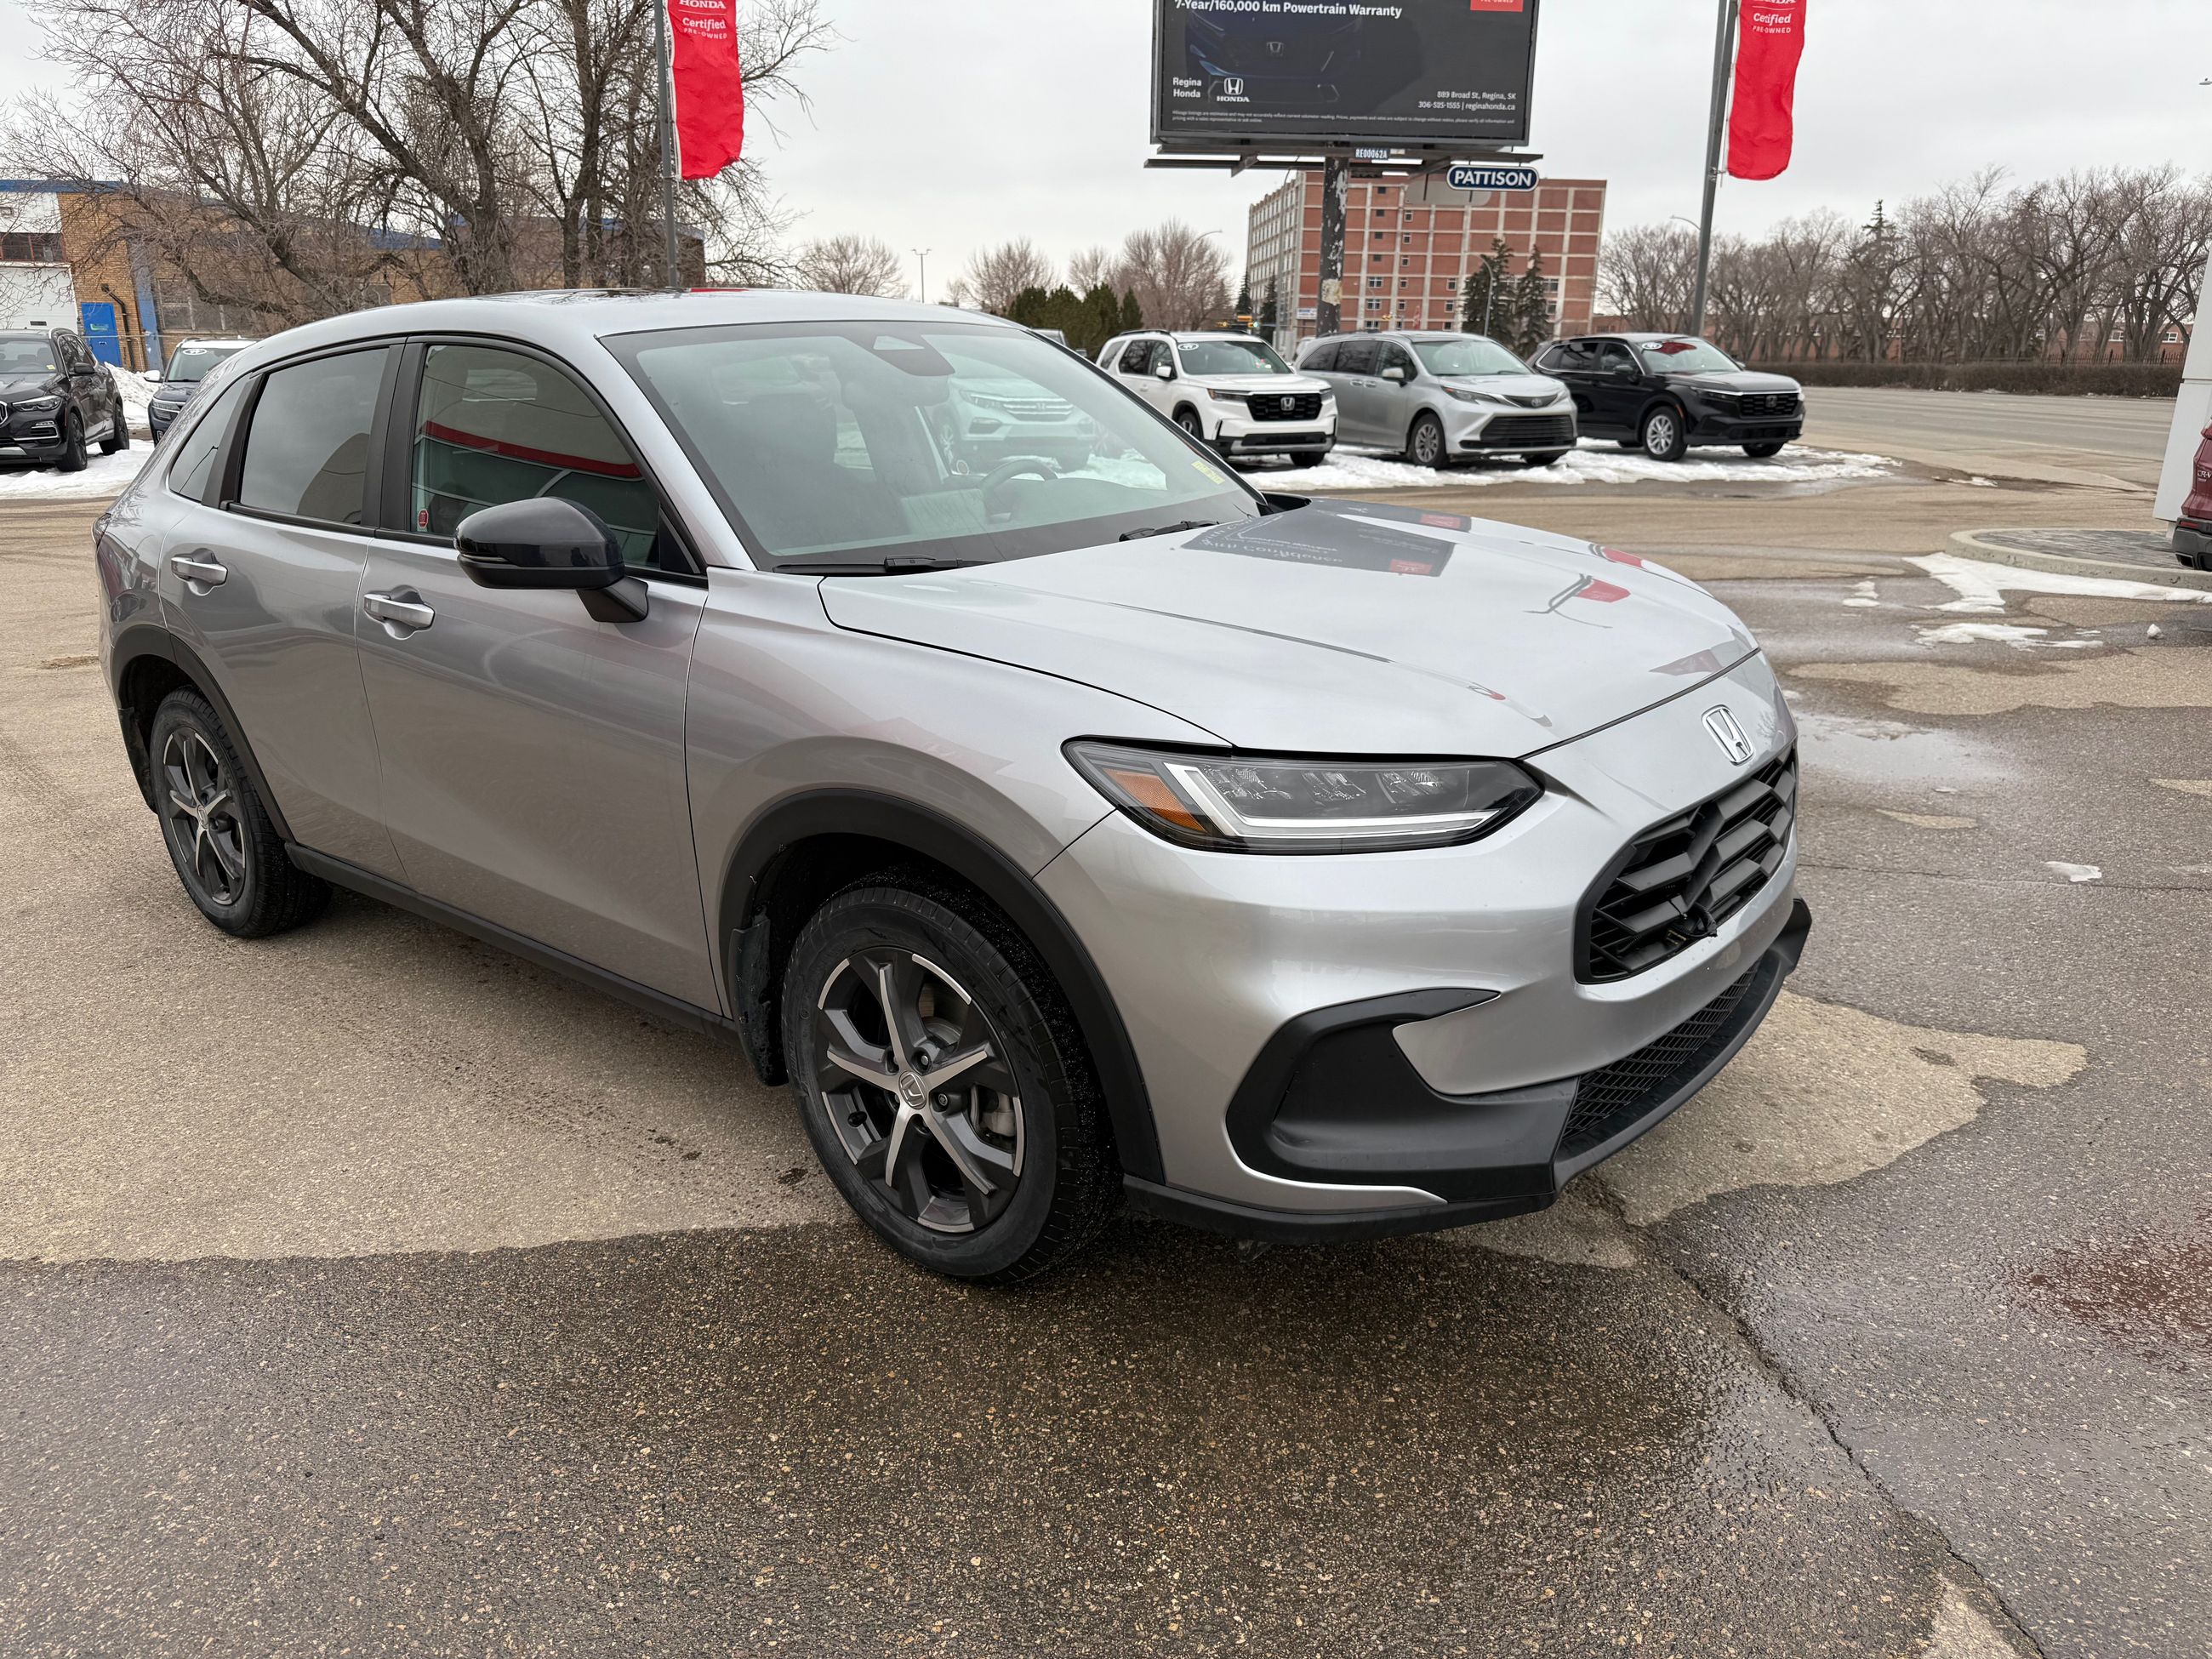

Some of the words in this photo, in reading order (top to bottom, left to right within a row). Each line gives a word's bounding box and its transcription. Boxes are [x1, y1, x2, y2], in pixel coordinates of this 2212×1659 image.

[679, 0, 727, 9] HONDA
[1176, 0, 1260, 13] 7-Year/160,000
[1262, 1, 1281, 13] km
[1283, 2, 1347, 14] Powertrain
[1348, 3, 1403, 19] Warranty
[682, 17, 727, 31] Certified
[683, 27, 727, 39] PRE-OWNED
[1753, 26, 1792, 34] PRE-OWNED
[1172, 77, 1202, 88] Regina
[1173, 88, 1201, 98] Honda
[1454, 169, 1532, 187] PATTISON
